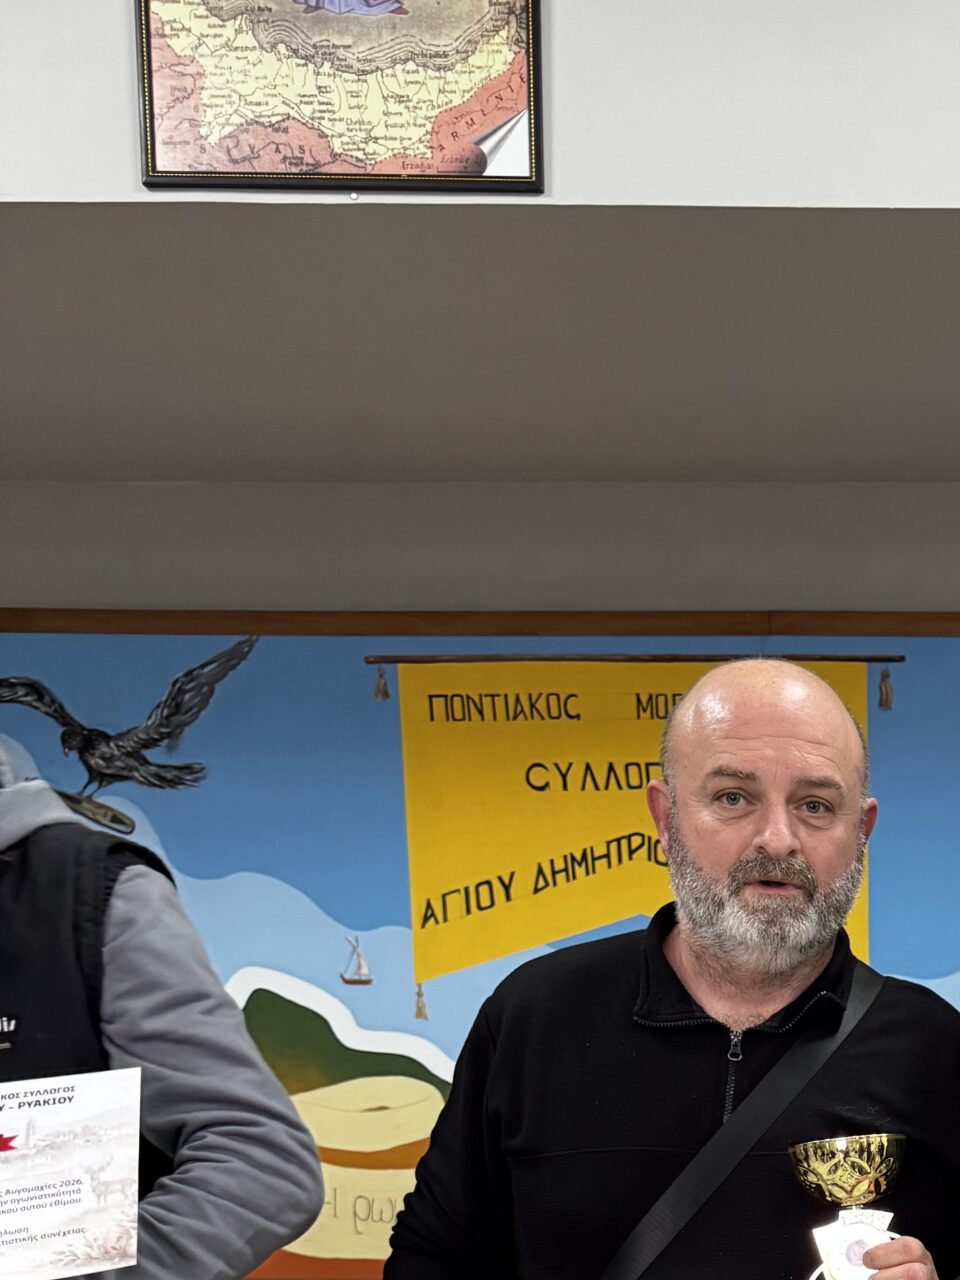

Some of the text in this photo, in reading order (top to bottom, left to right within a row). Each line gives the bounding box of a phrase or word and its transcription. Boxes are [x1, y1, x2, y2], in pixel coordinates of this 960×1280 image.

[421, 871, 516, 929] ΑΓΙΟΥ
[23, 1085, 77, 1097] ΣΥΛΛΟΓΟΣ
[18, 1096, 75, 1109] ΡΥΑΚΙΟΥ
